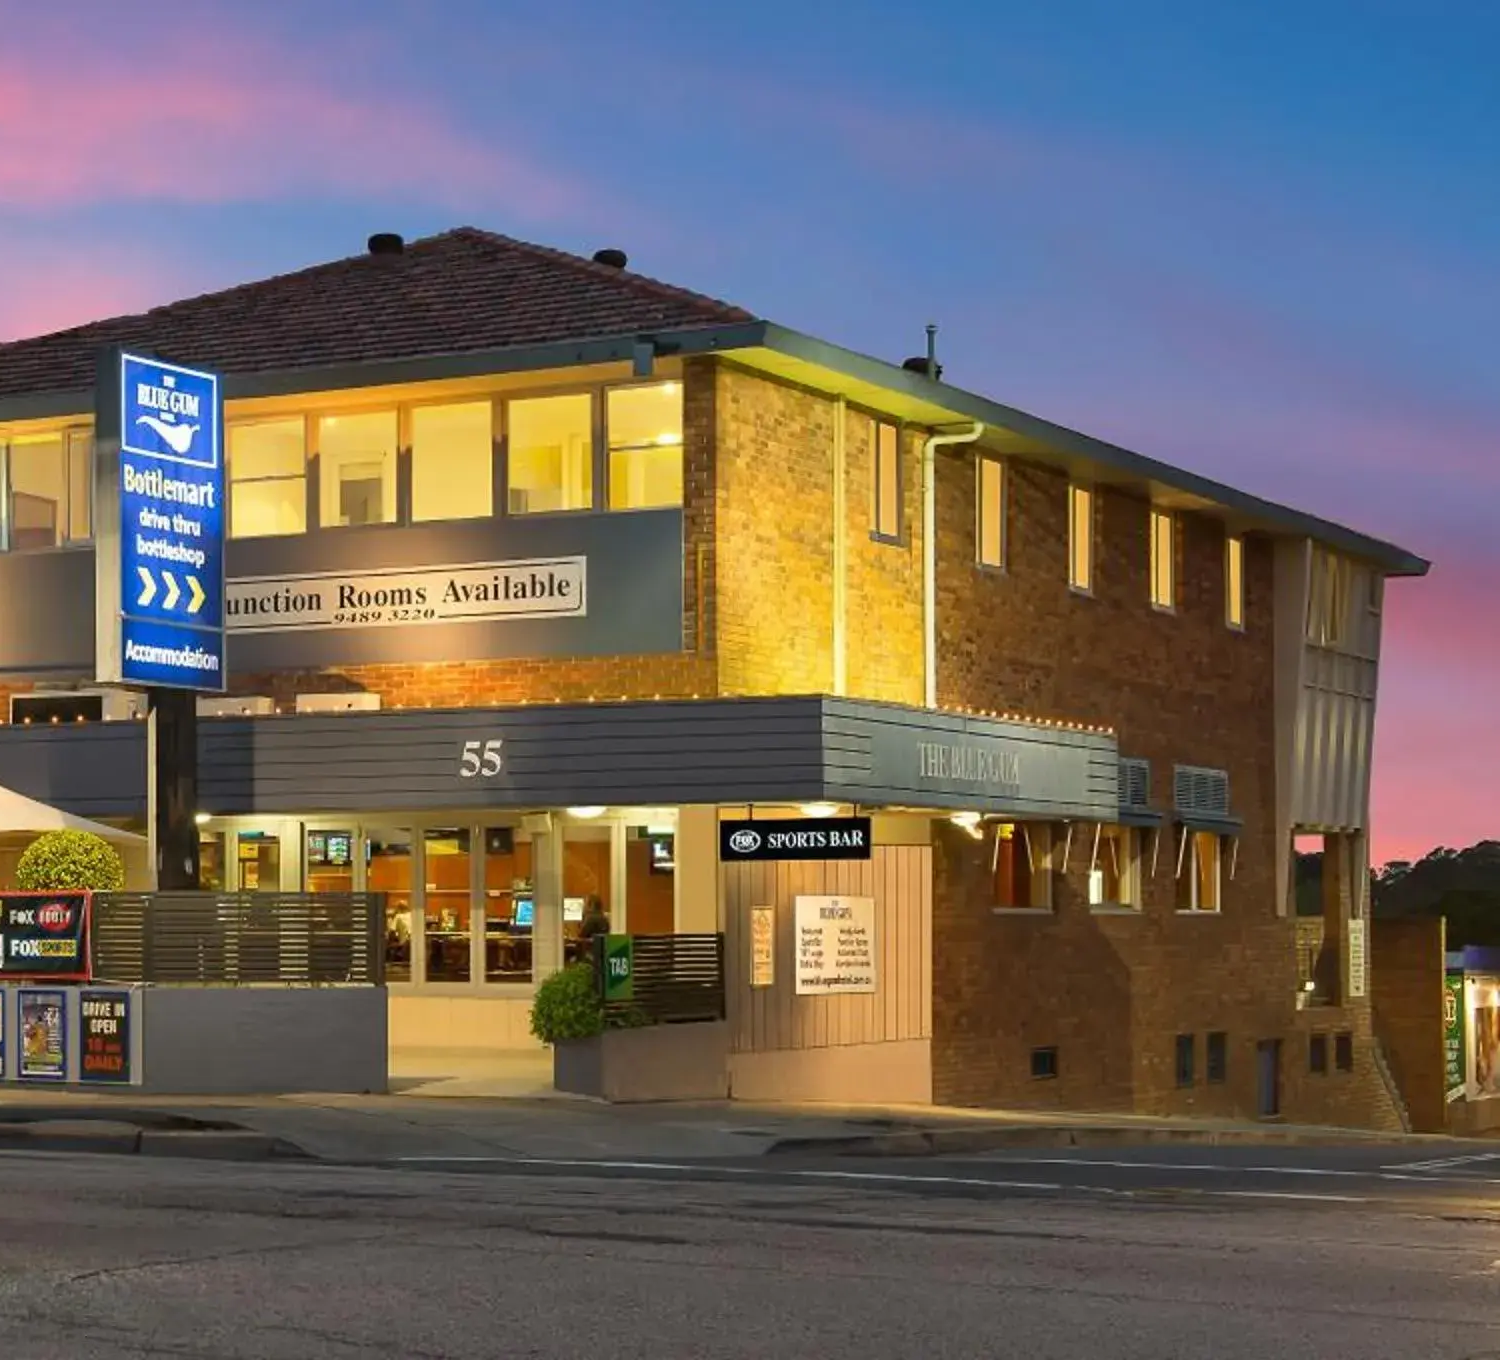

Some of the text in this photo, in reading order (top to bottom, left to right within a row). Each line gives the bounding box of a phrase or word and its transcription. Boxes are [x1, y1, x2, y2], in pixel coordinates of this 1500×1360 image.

[137, 383, 169, 411] BLUE
[170, 391, 199, 417] GUM
[124, 463, 215, 508] Bottlemart
[139, 506, 201, 536] drive thru
[136, 533, 205, 569] bottleshop
[226, 571, 572, 615] unction Rooms Available
[333, 608, 436, 624] 9489 3220
[125, 639, 219, 671] Accommodation
[460, 740, 502, 777] 55
[918, 742, 949, 777] THE
[767, 832, 827, 848] SPORTS
[829, 829, 863, 847] BAR
[9, 909, 35, 925] FOX
[11, 940, 40, 956] FOX
[609, 957, 629, 976] TAB
[82, 1001, 112, 1017] DRIVE
[90, 1019, 117, 1034] OPEN
